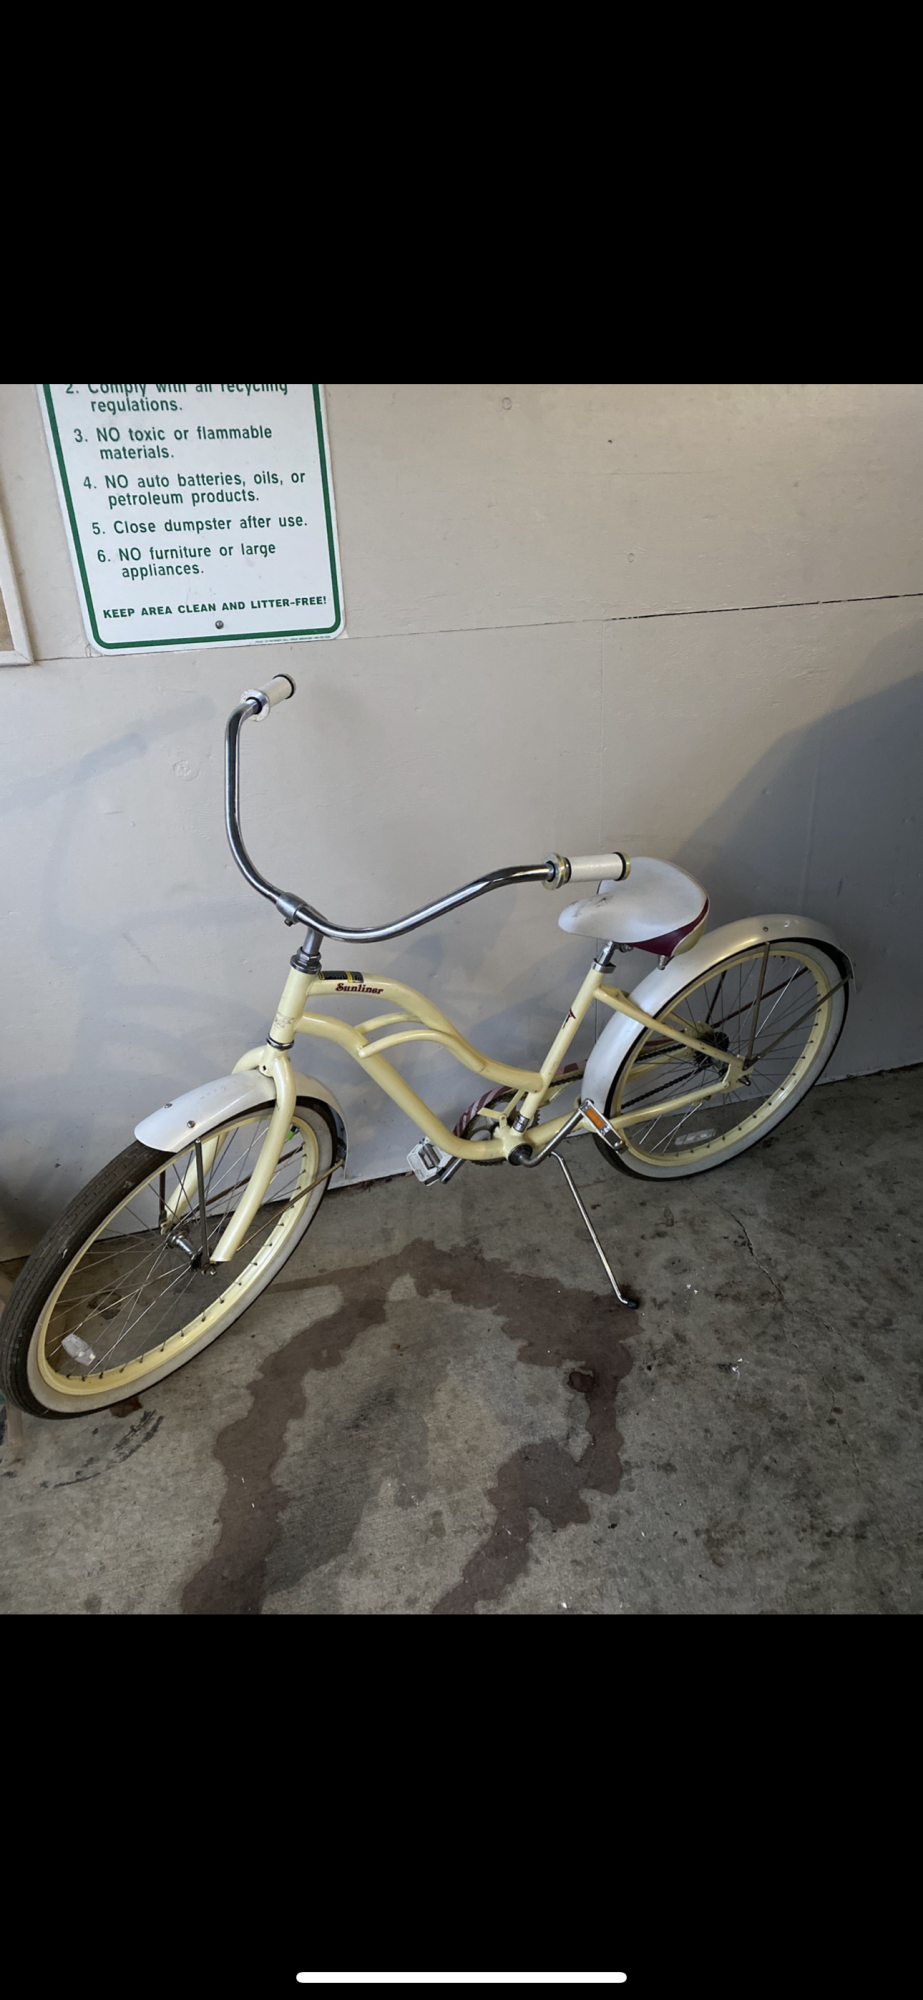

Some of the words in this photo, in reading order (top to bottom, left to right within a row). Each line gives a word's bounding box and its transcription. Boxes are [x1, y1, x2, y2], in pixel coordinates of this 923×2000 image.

[64, 384, 79, 394] 2.
[90, 397, 183, 416] regulations.
[73, 428, 88, 443] 3.
[96, 427, 120, 442] NO
[128, 427, 166, 441] toxic
[173, 428, 190, 440] or
[196, 425, 273, 440] flammable
[99, 444, 174, 461] materials.
[82, 477, 97, 490] 4.
[104, 475, 129, 489] NO
[137, 474, 170, 488] auto
[177, 472, 247, 487] batteries,
[253, 470, 284, 486] oils,
[290, 472, 306, 484] or
[107, 490, 184, 510] petroleum
[191, 488, 260, 507] products.
[91, 522, 106, 535] 5.
[113, 520, 157, 535] Close
[164, 516, 232, 534] dumpster
[239, 515, 272, 530] after
[278, 515, 308, 527] use.
[96, 549, 111, 563] 6.
[118, 546, 142, 562] NO
[149, 544, 212, 560] furniture
[219, 545, 234, 557] or
[241, 542, 276, 558] large
[121, 562, 205, 581] appliances.
[102, 608, 135, 619] KEEP
[140, 606, 173, 616] AREA
[177, 603, 217, 614] CLEAN
[221, 601, 246, 611] AND
[250, 596, 328, 610] LITTER-FREE!
[335, 983, 384, 994] Sunliner
